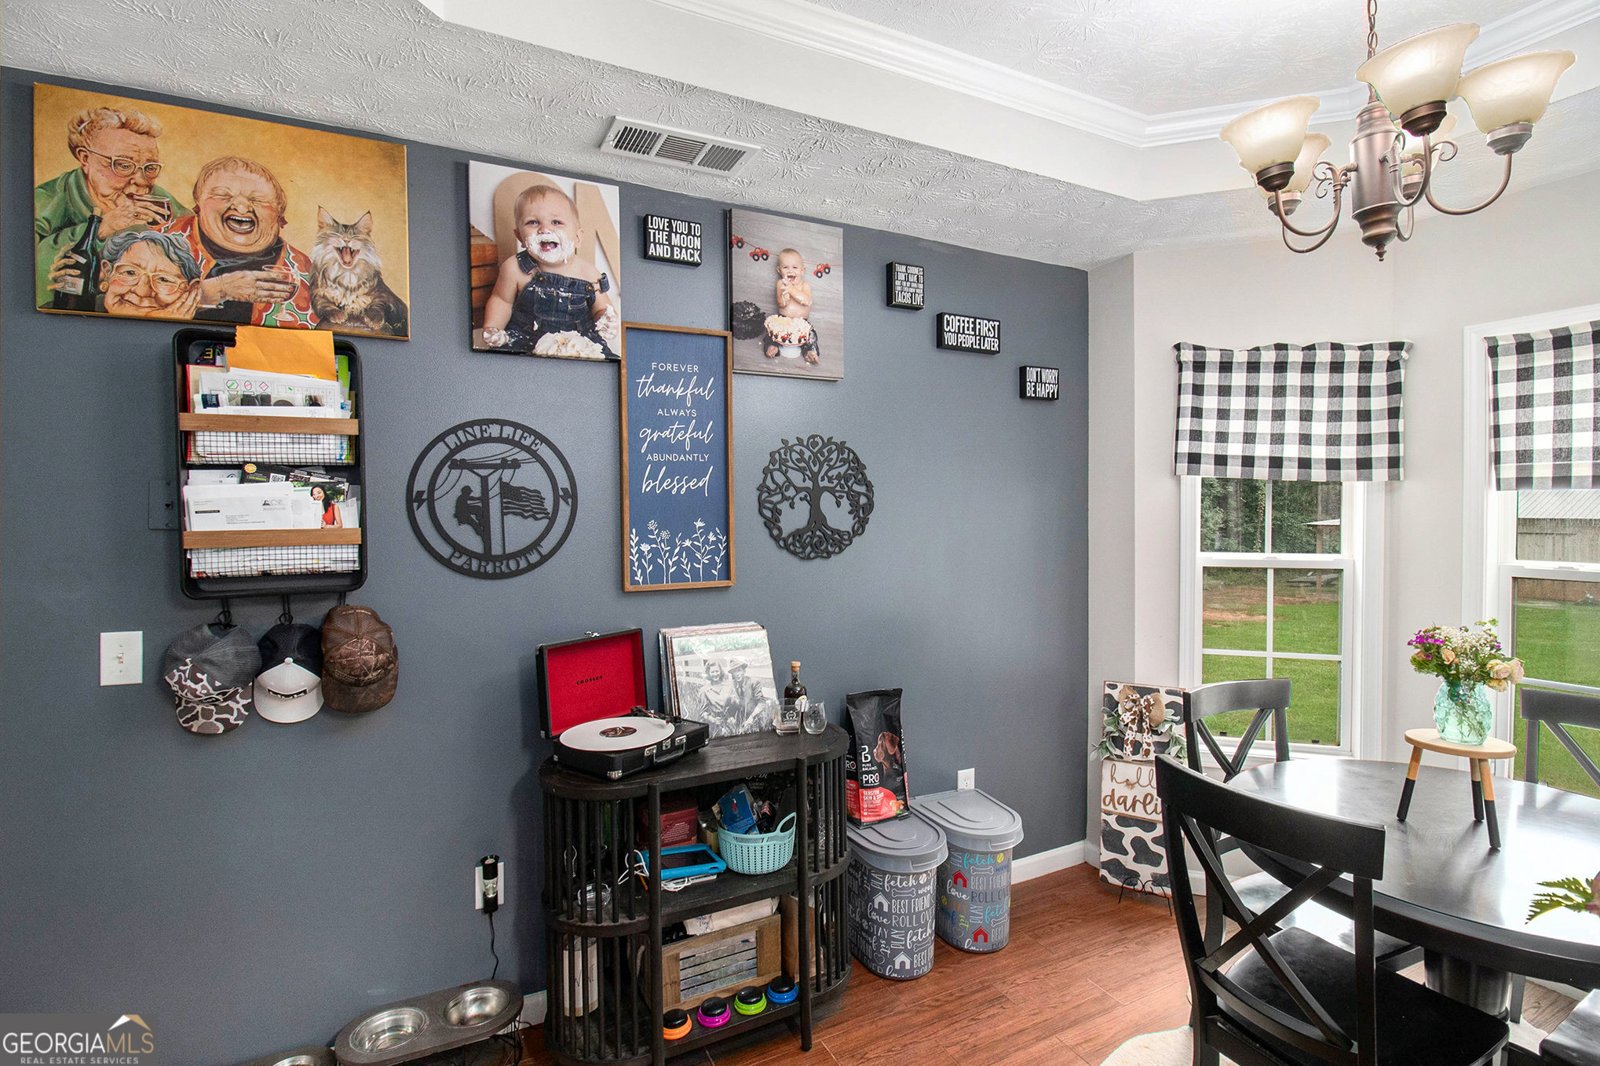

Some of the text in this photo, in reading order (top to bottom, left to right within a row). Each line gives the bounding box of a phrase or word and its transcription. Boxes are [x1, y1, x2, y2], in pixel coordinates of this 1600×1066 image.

[648, 215, 701, 236] LOVE YOU TO
[648, 229, 701, 249] THE MOON
[649, 243, 701, 262] AND BACK
[895, 290, 924, 306] TACOS LIVE
[944, 314, 999, 338] COFFEE FIRST
[944, 331, 999, 351] YOU PEOPLE LATER
[651, 362, 699, 373] FOREVER
[1041, 368, 1059, 384] WORRY
[636, 372, 715, 407] thankful
[1026, 381, 1059, 398] BE HAPPY
[657, 408, 697, 417] ALWAYS
[442, 424, 544, 452] LINE LIFE
[639, 419, 714, 453] grateful
[646, 453, 709, 462] ABUNDANTLY
[641, 463, 714, 497] blessed
[449, 543, 545, 574] PARROTT
[862, 772, 880, 784] PRO
[1111, 763, 1156, 790] hll
[1103, 788, 1161, 815] darli
[963, 853, 995, 869] fetch
[884, 873, 918, 892] fetch
[946, 879, 970, 901] love
[971, 876, 987, 891] BEST
[891, 899, 908, 914] BEST
[970, 890, 995, 904] ROLL
[867, 902, 891, 925] love
[892, 914, 918, 928] ROLL
[868, 921, 888, 939] STAY
[890, 928, 905, 949] PLAY
[913, 949, 927, 968] BEST
